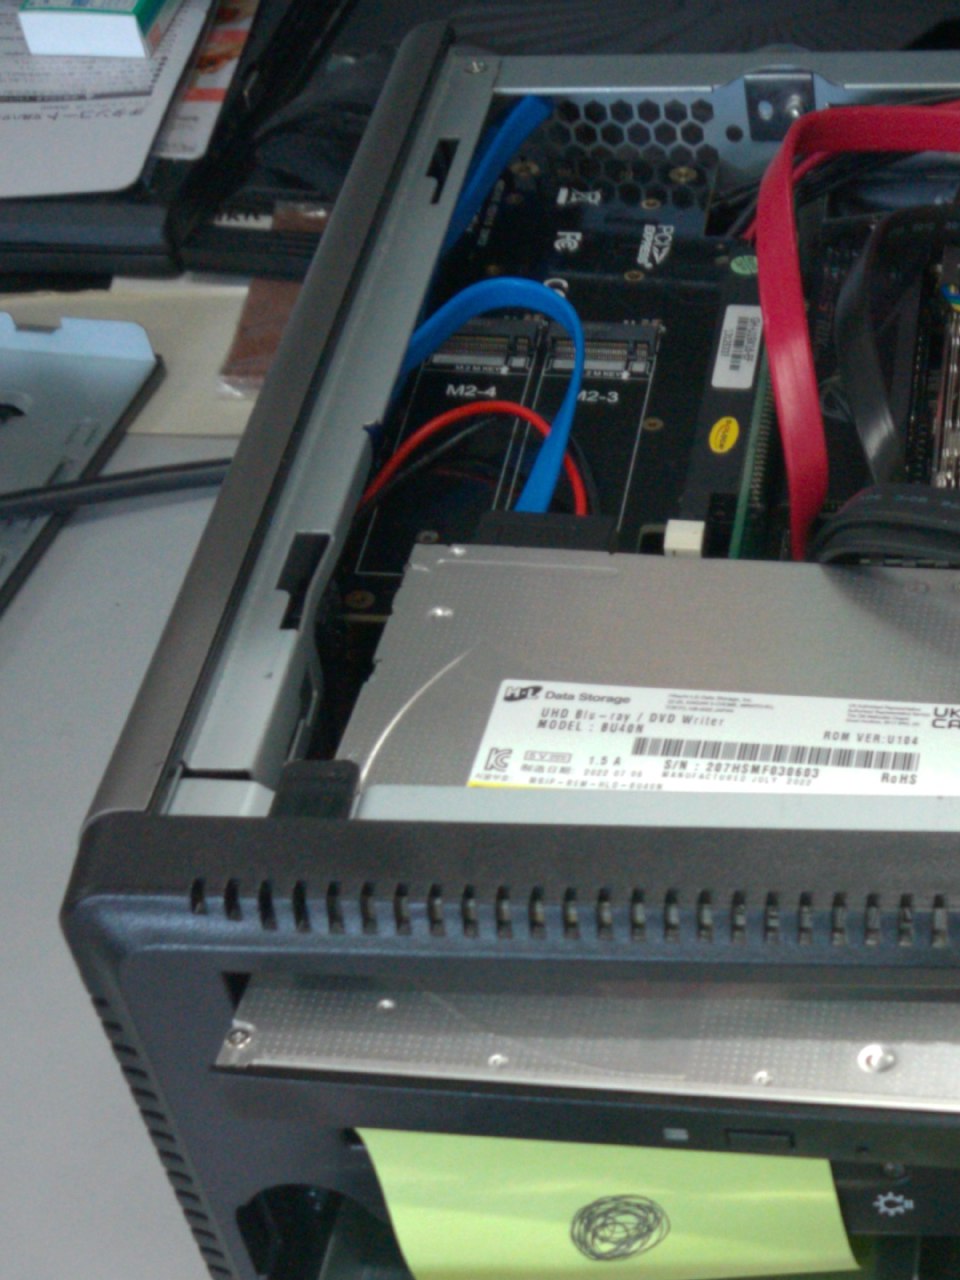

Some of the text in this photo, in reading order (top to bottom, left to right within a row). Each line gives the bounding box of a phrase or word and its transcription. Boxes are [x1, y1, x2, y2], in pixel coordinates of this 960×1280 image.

[445, 384, 497, 398] M2-4
[545, 690, 575, 700] Data
[578, 691, 631, 705] Storage
[541, 708, 569, 719] UHD
[649, 712, 677, 724] DVD
[682, 714, 725, 727] Writer
[537, 719, 583, 732] MODEL
[823, 731, 850, 741] ROM
[664, 759, 688, 771] S/N
[881, 772, 918, 785] RoHS
